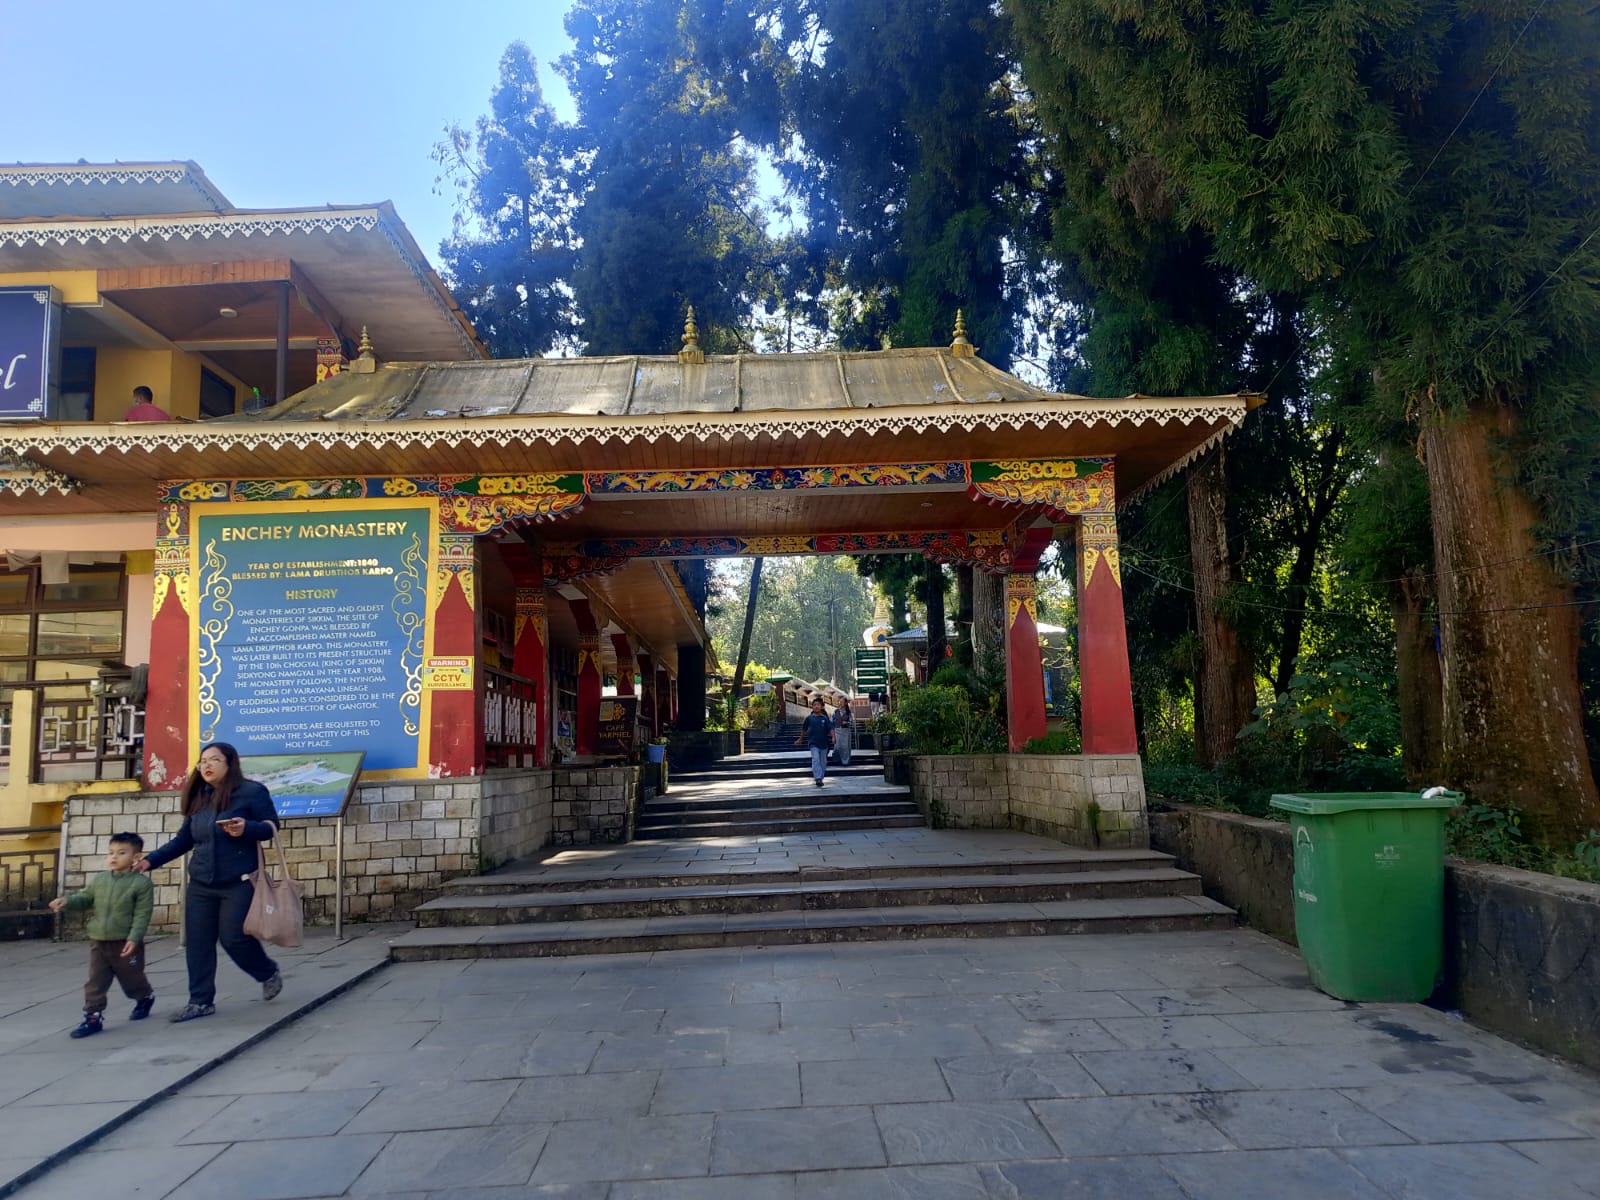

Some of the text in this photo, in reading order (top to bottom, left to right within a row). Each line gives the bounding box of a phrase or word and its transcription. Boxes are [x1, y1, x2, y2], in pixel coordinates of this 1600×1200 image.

[0, 354, 26, 389] l
[221, 521, 407, 541] ENCHEY MONASTERY
[232, 572, 267, 580] BLESSED
[285, 570, 311, 578] LAMA
[363, 567, 394, 575] KARPO
[286, 589, 338, 600] HISTORY
[237, 672, 276, 680] SIDKYONG
[308, 694, 356, 702] CONSIDERED
[236, 723, 308, 732] DEVOTEES/VISITORS
[325, 720, 368, 728] REQUESTED
[304, 730, 338, 738] SANCTITY
